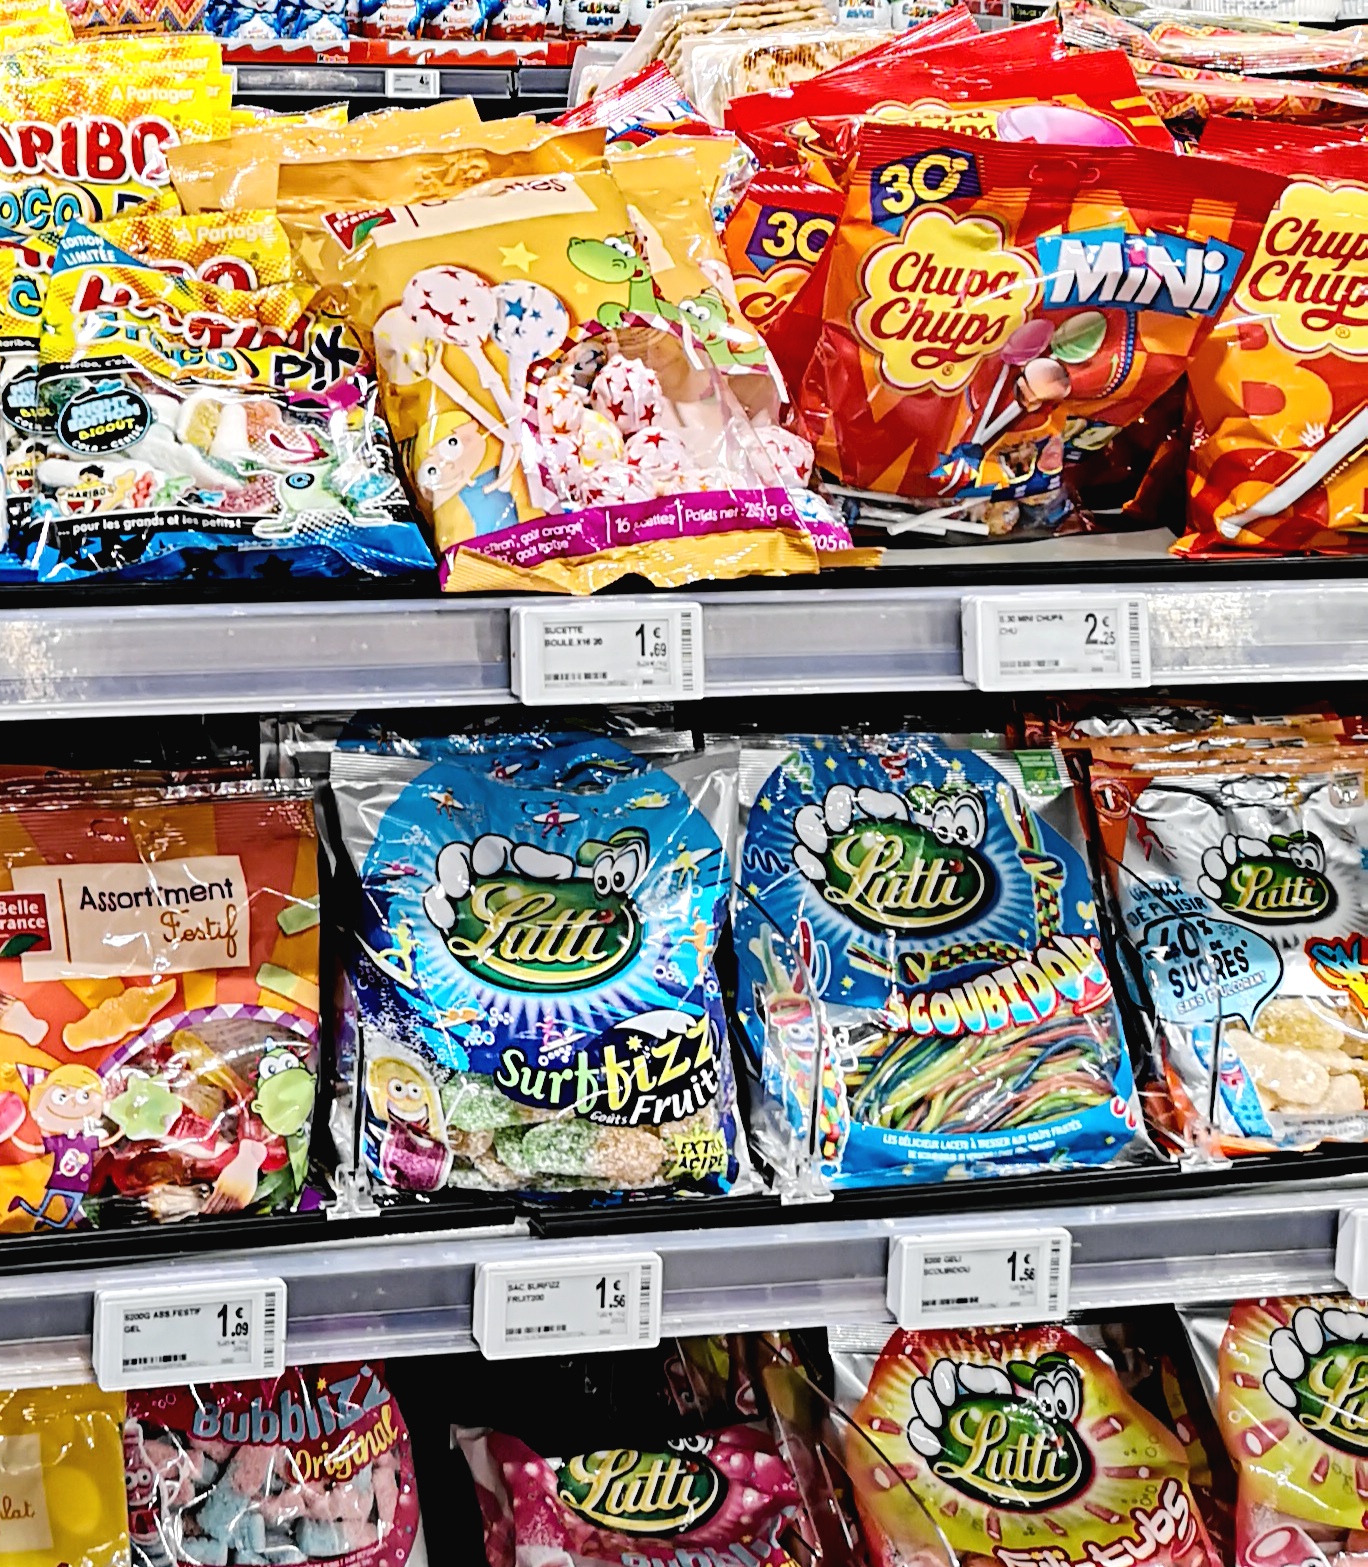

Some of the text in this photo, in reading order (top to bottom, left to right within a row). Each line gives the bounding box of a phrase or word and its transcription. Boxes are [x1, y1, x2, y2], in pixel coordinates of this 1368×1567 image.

[126, 85, 196, 106] Partager
[889, 250, 1020, 310] Chupa
[873, 296, 1010, 368] Chups
[70, 394, 131, 420] NIGHT
[67, 488, 107, 499] HARIBO
[72, 520, 101, 534] pour
[102, 518, 121, 530] les
[123, 516, 165, 533] grands
[167, 514, 180, 526] et
[615, 515, 631, 534] 16
[544, 625, 583, 634] SUCETTE
[79, 876, 235, 913] Assortiment
[822, 832, 968, 910] Lutti
[1222, 865, 1319, 914] Lutti
[159, 903, 239, 959] Festif
[447, 881, 617, 964] Lutti
[630, 1069, 720, 1124] Fruit
[124, 1324, 141, 1334] GEL
[290, 1404, 400, 1480] Original
[933, 1409, 1066, 1482] Lutti
[560, 1449, 700, 1515] Lutti
